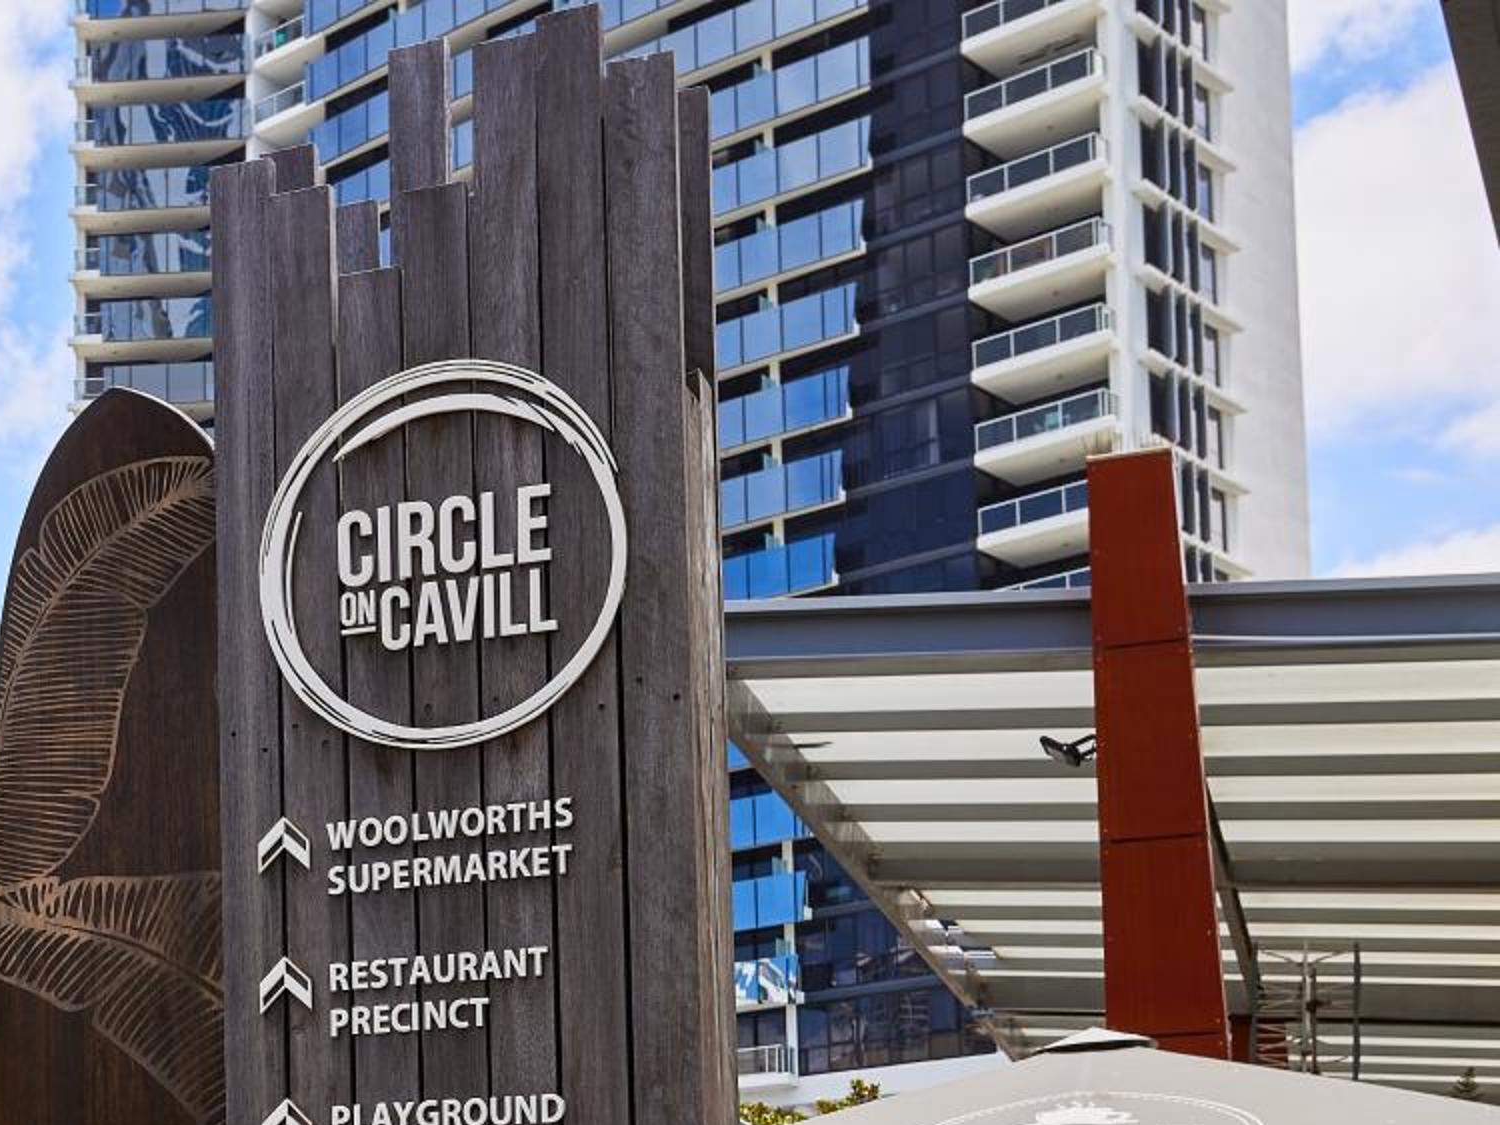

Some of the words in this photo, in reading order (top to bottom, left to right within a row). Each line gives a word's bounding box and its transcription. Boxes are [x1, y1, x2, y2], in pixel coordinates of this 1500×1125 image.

[337, 483, 552, 587] CIRCLE
[340, 589, 376, 628] ON
[380, 568, 559, 651] CAVILL
[326, 797, 574, 851] WOOLWORTHS
[327, 844, 573, 895] SUPERMARKET
[329, 946, 549, 992] RESTAURANT
[329, 997, 490, 1037] PRECINCT
